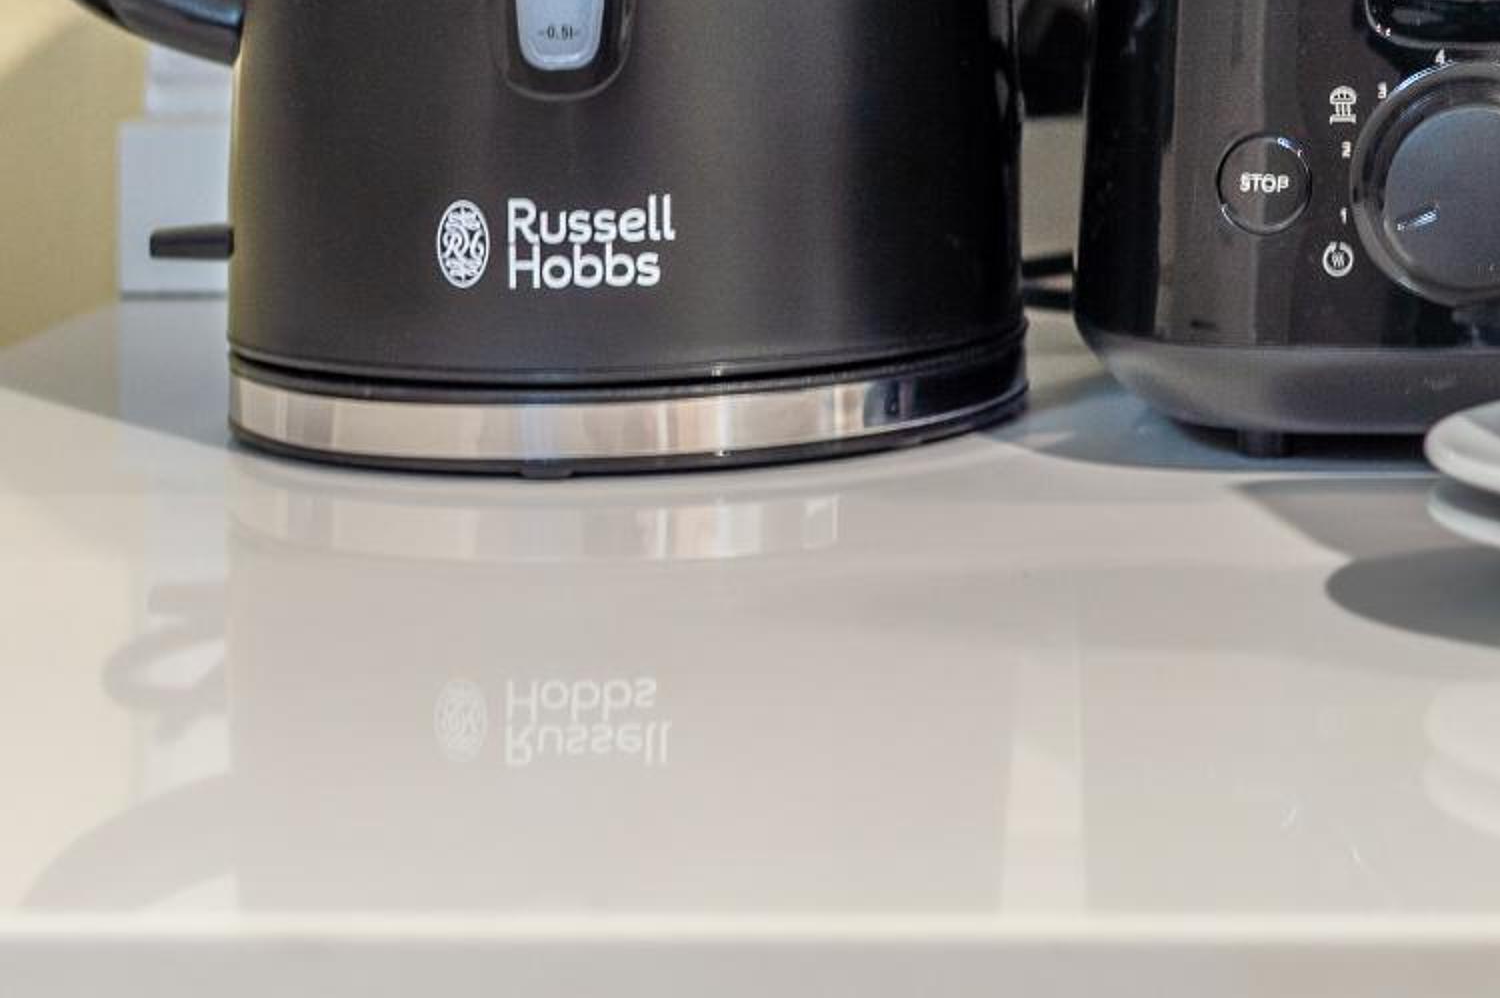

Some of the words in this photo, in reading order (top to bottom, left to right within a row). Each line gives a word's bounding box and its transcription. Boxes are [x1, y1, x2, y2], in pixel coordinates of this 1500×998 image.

[1435, 48, 1446, 64] 4
[1341, 141, 1352, 159] 2
[1239, 172, 1290, 193] STOP
[506, 193, 676, 244] Russell
[1340, 207, 1348, 224] 1
[508, 240, 661, 290] Hobbs
